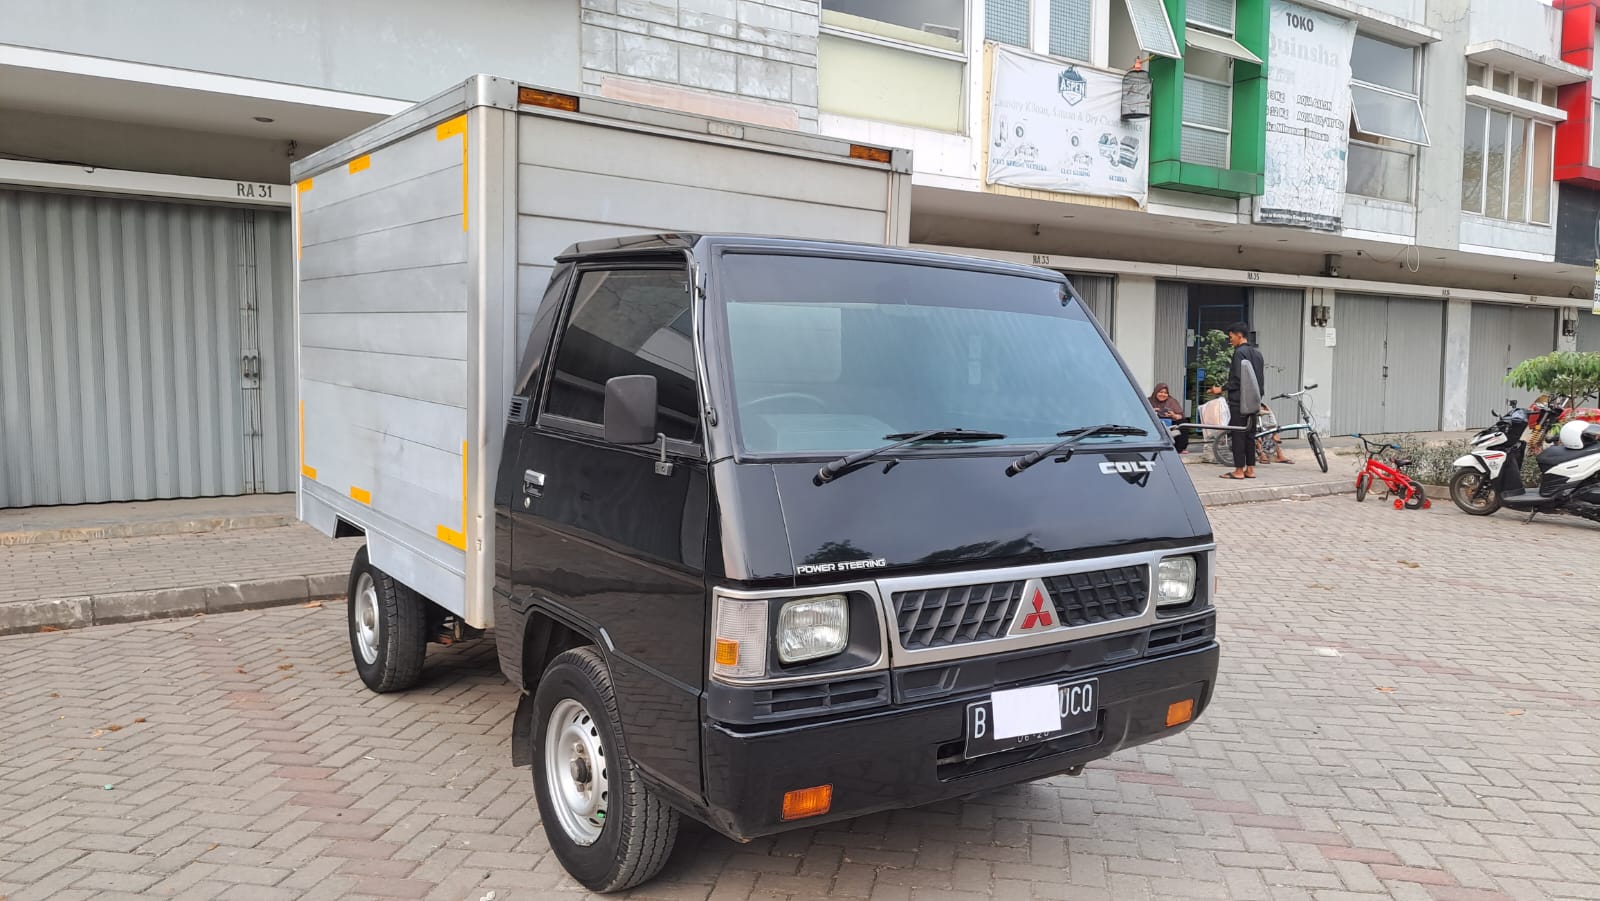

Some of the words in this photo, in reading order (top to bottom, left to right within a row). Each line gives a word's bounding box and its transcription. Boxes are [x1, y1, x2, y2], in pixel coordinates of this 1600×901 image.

[1286, 12, 1314, 32] TOKO
[1059, 79, 1086, 95] ASPEN
[237, 183, 254, 197] RA
[259, 185, 272, 198] 31
[1099, 461, 1155, 474] COLT
[797, 563, 835, 575] POWER
[838, 559, 886, 571] STEERING
[975, 707, 986, 738] B
[1060, 684, 1093, 718] UCQ
